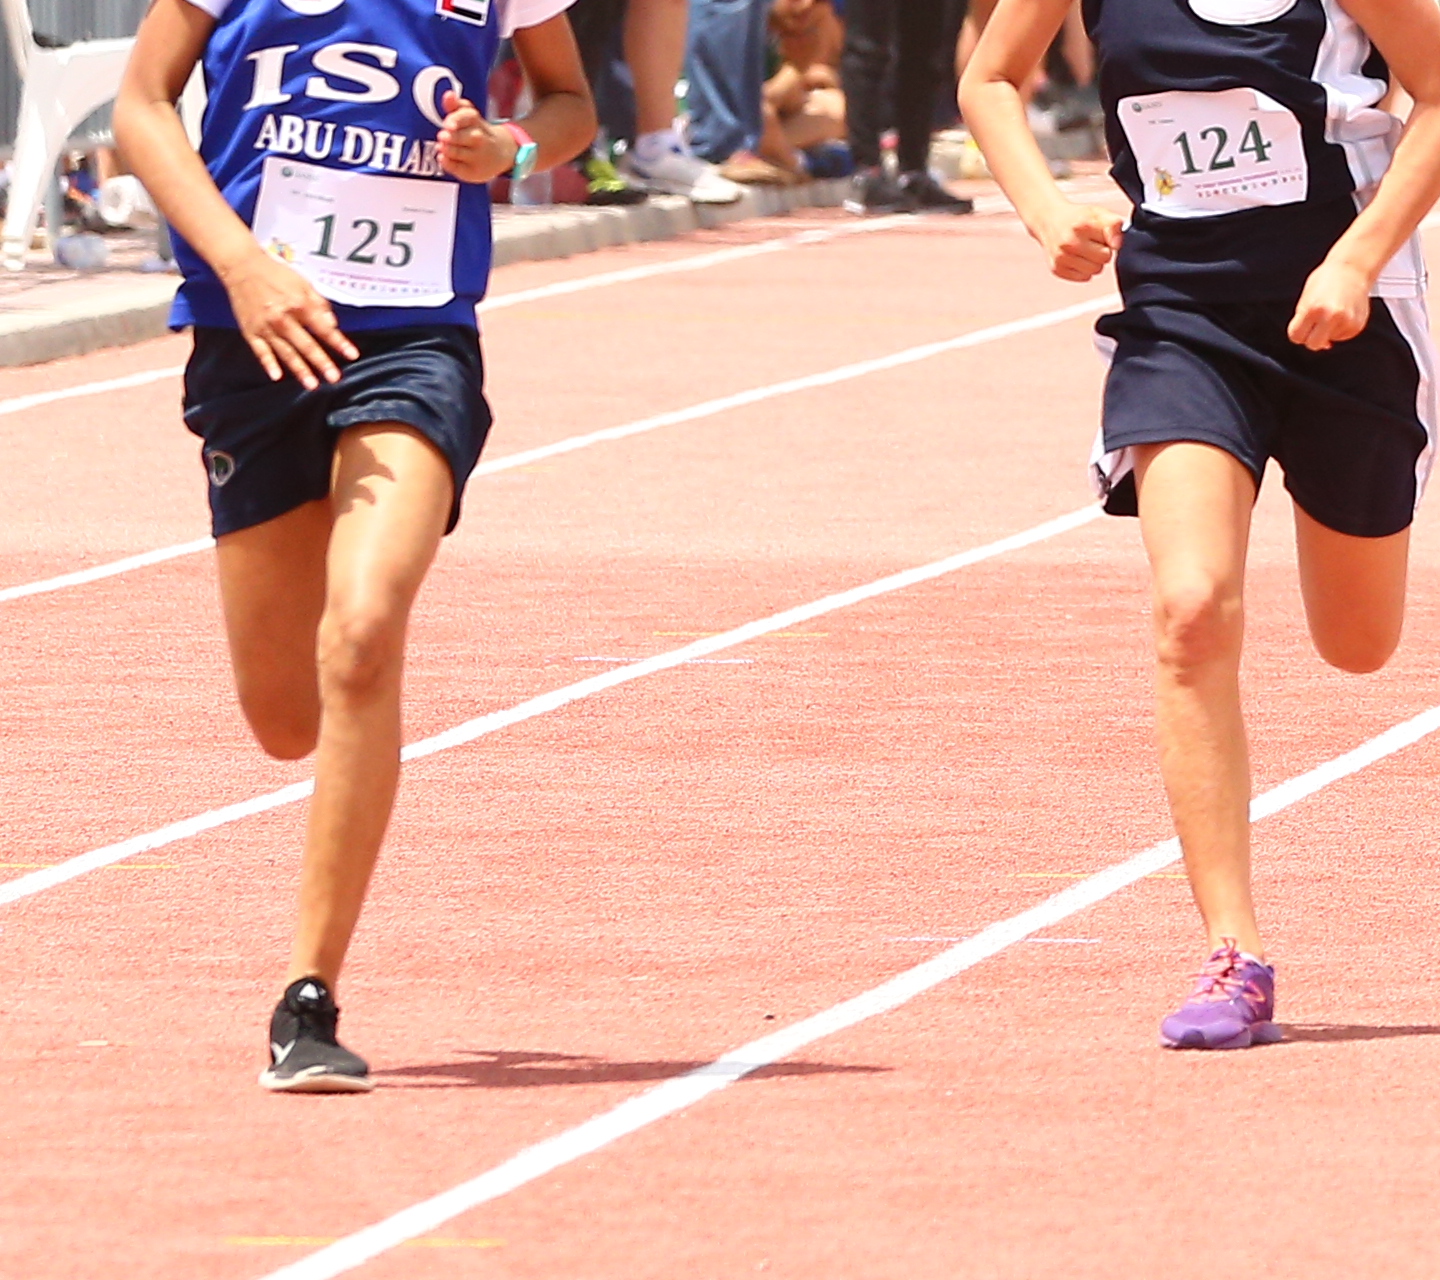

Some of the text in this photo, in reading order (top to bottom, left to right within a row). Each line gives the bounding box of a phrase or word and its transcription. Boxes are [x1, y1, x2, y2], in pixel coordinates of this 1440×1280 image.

[253, 113, 337, 160] ABU
[1173, 119, 1272, 175] 124
[309, 213, 415, 268] 125
